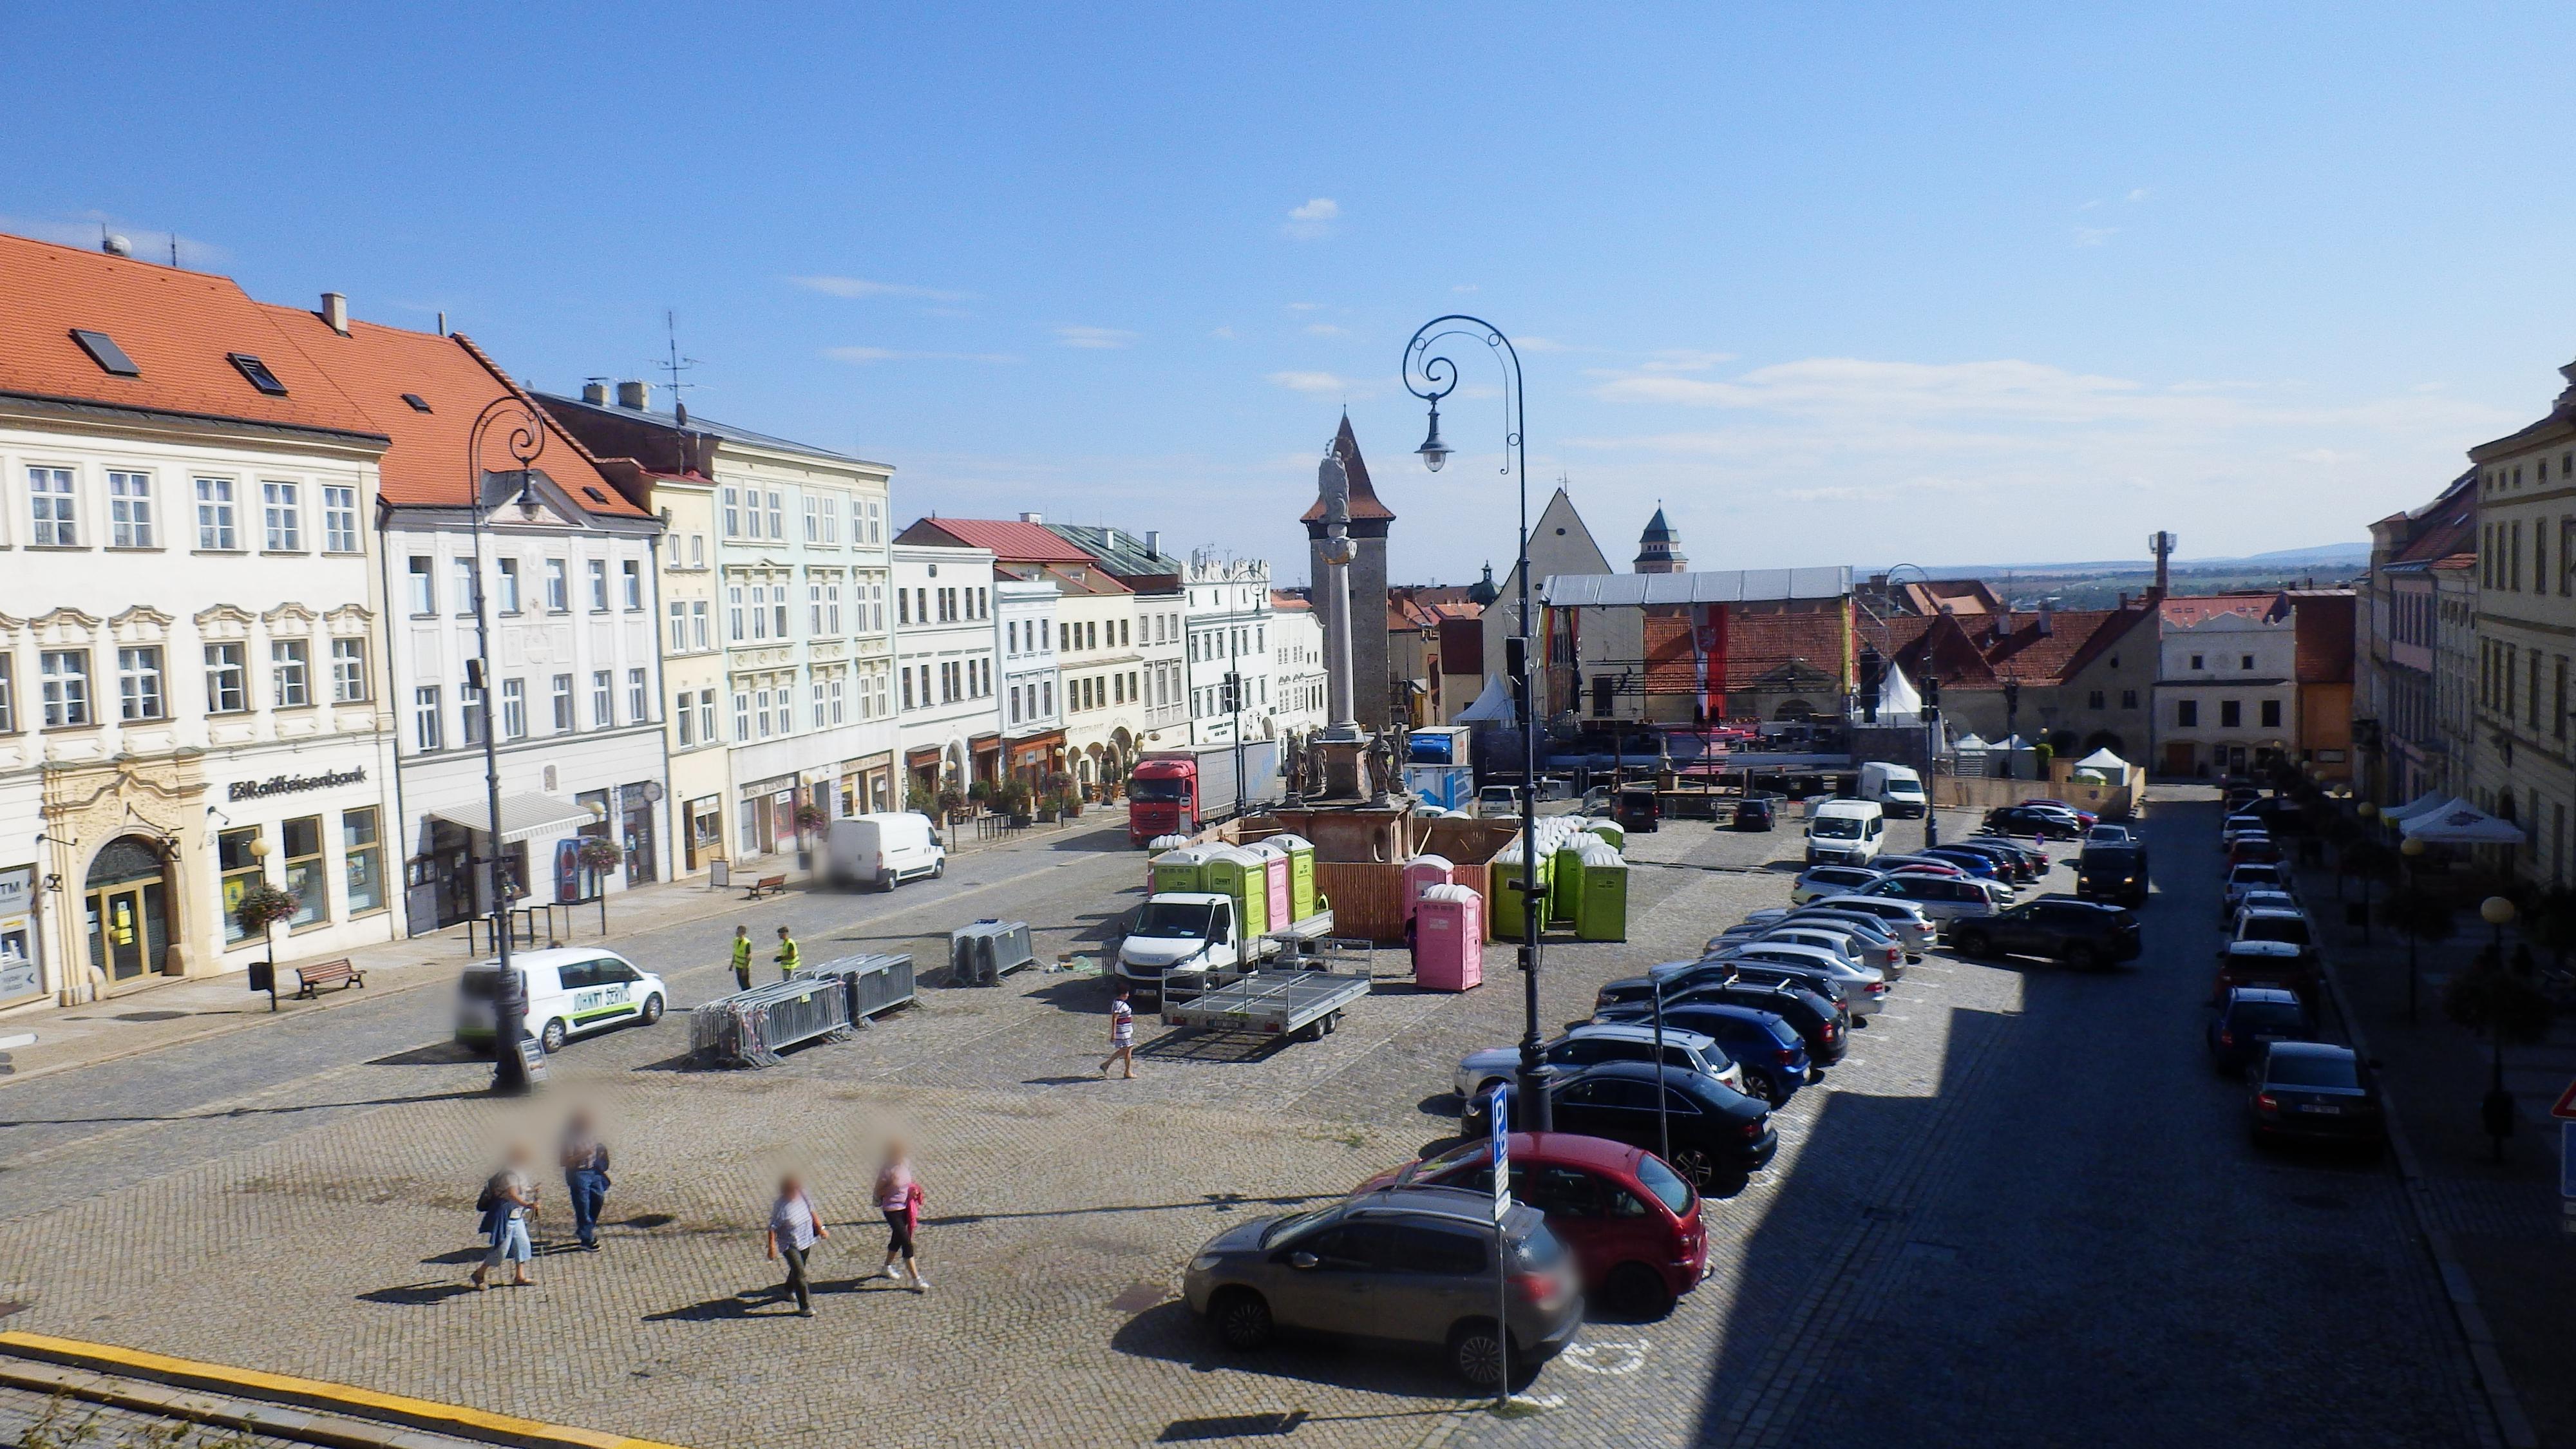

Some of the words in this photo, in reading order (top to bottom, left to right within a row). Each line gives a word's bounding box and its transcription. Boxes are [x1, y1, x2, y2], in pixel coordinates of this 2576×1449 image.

[245, 765, 367, 799] Raiffeisenbank
[574, 989, 603, 1012] JOHNNY
[605, 986, 630, 1005] SERVIS
